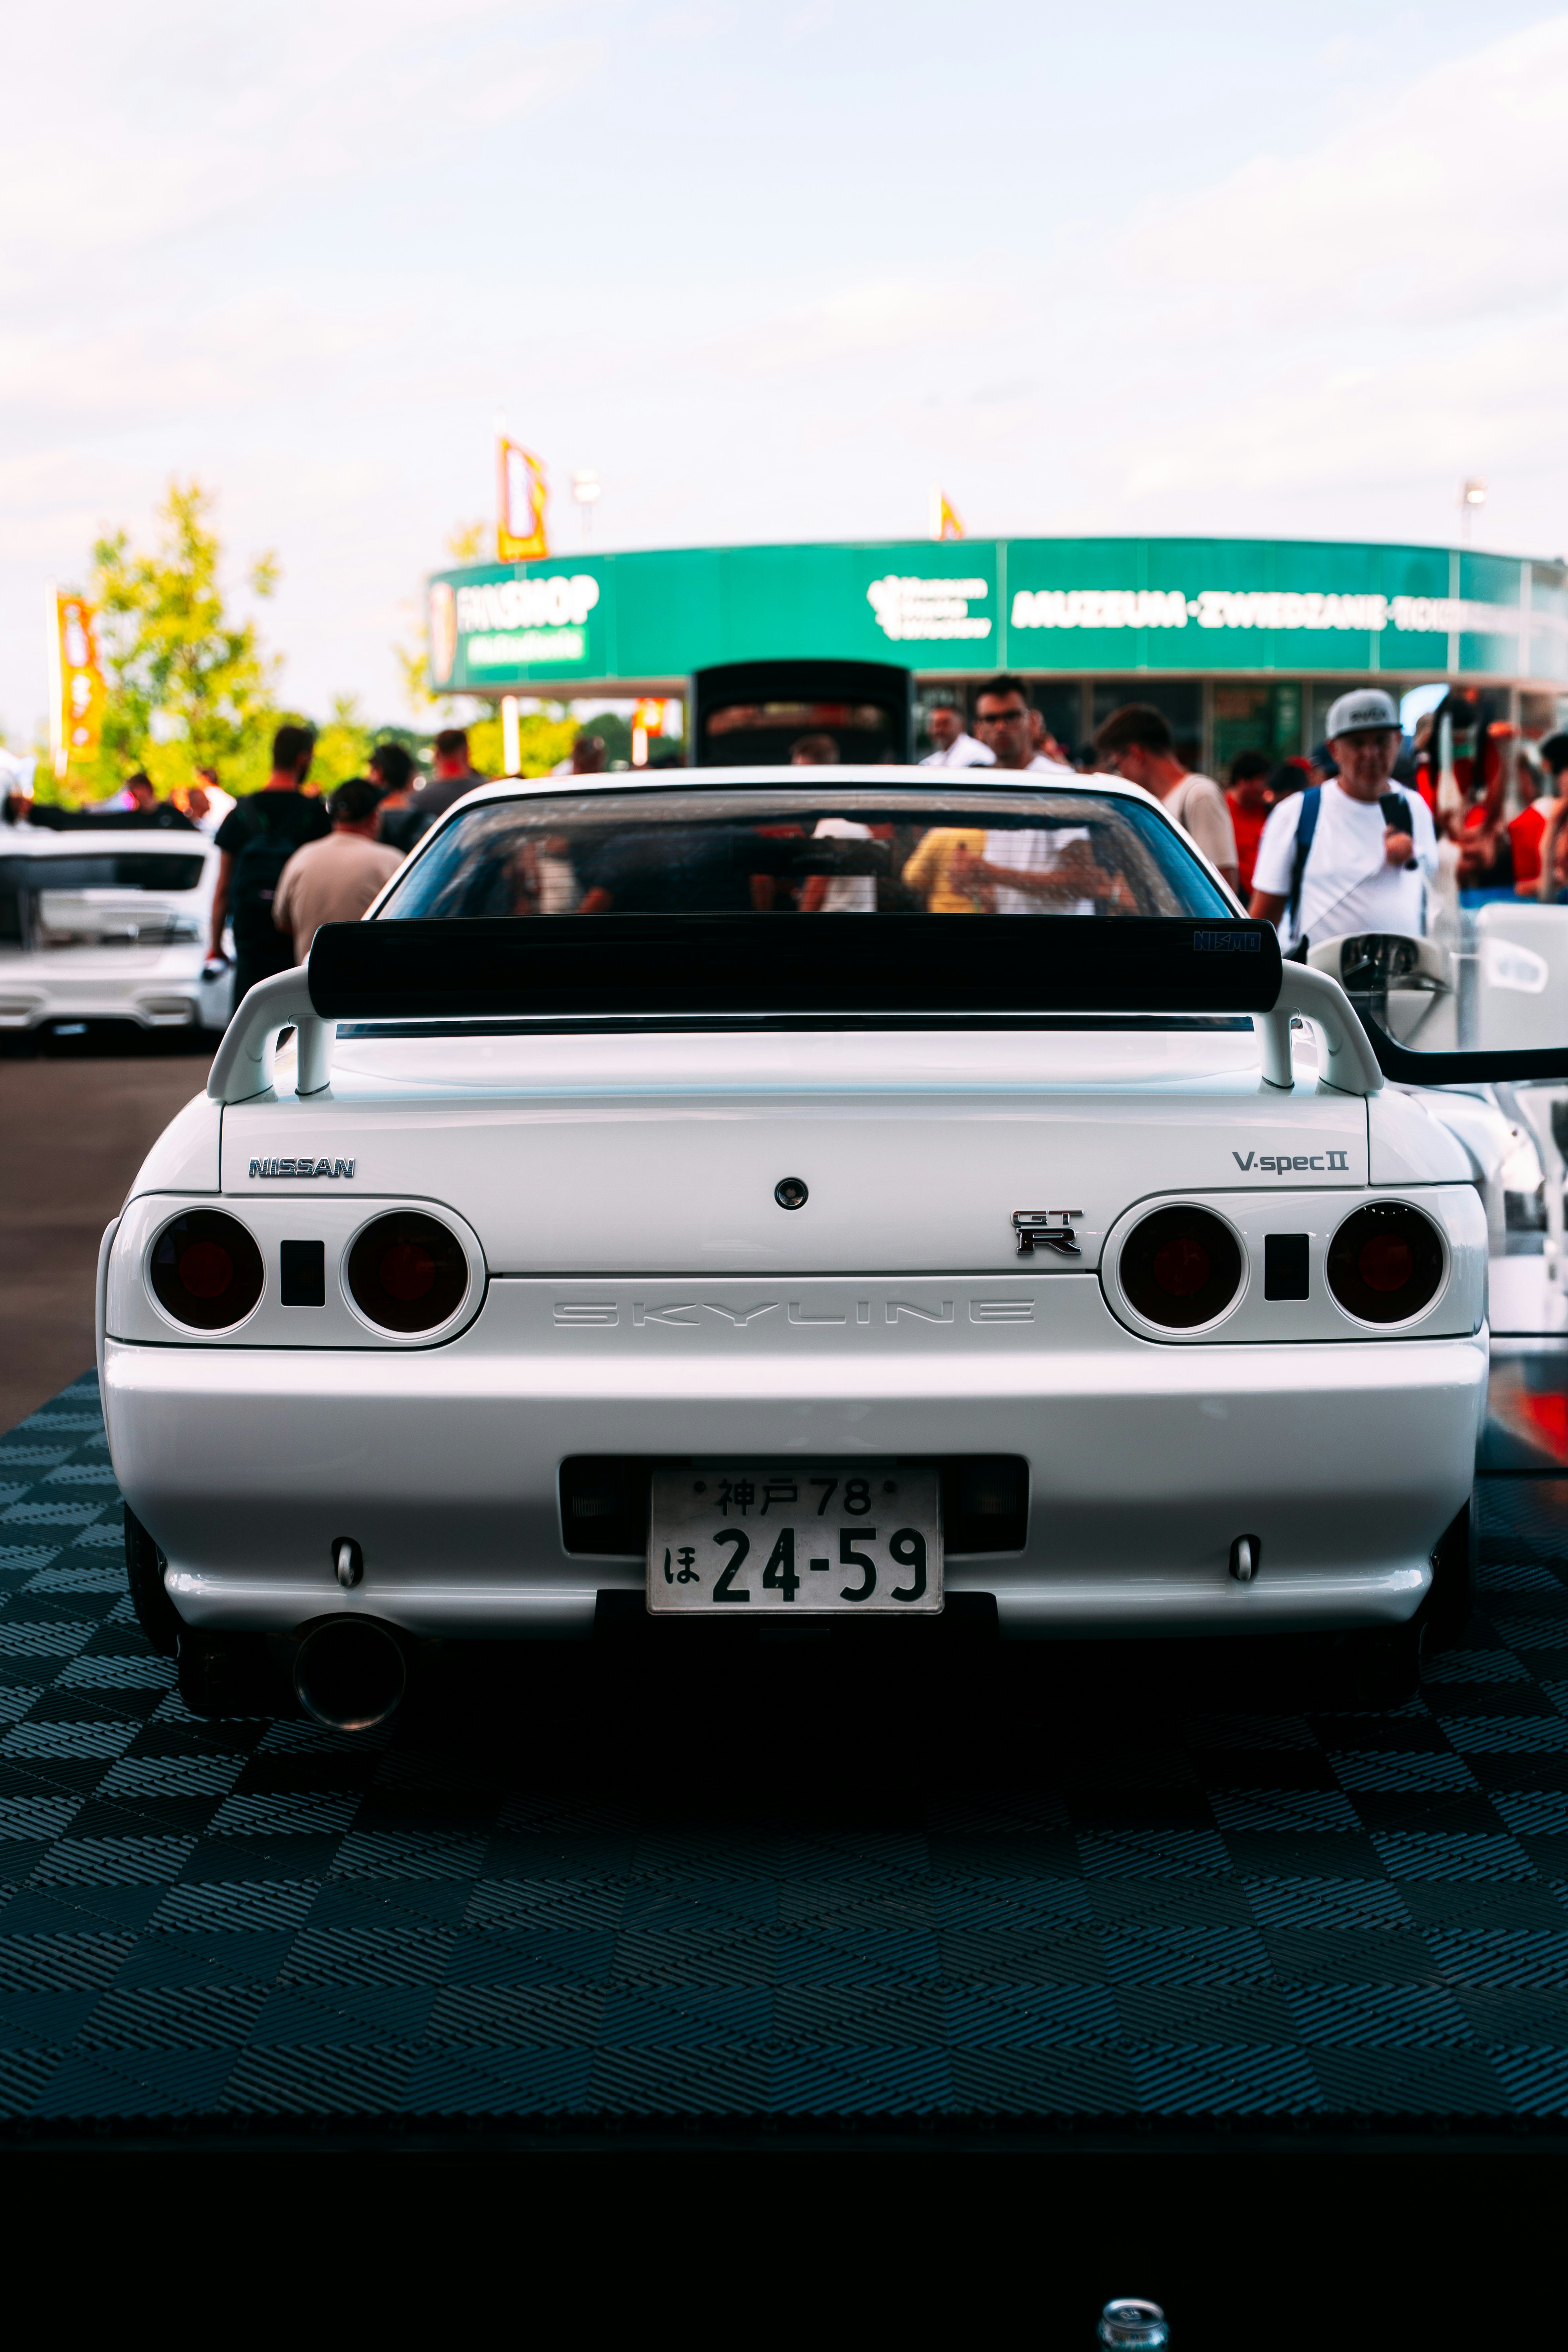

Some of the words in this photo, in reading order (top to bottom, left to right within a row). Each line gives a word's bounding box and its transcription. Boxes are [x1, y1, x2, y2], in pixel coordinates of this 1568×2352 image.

[1194, 931, 1261, 952] NISMO
[249, 1157, 355, 1176] NISSAN
[1011, 1209, 1084, 1227] GT
[1016, 1227, 1082, 1255] R
[553, 1299, 1035, 1327] SKYLINE
[712, 1527, 927, 1602] 24-59
